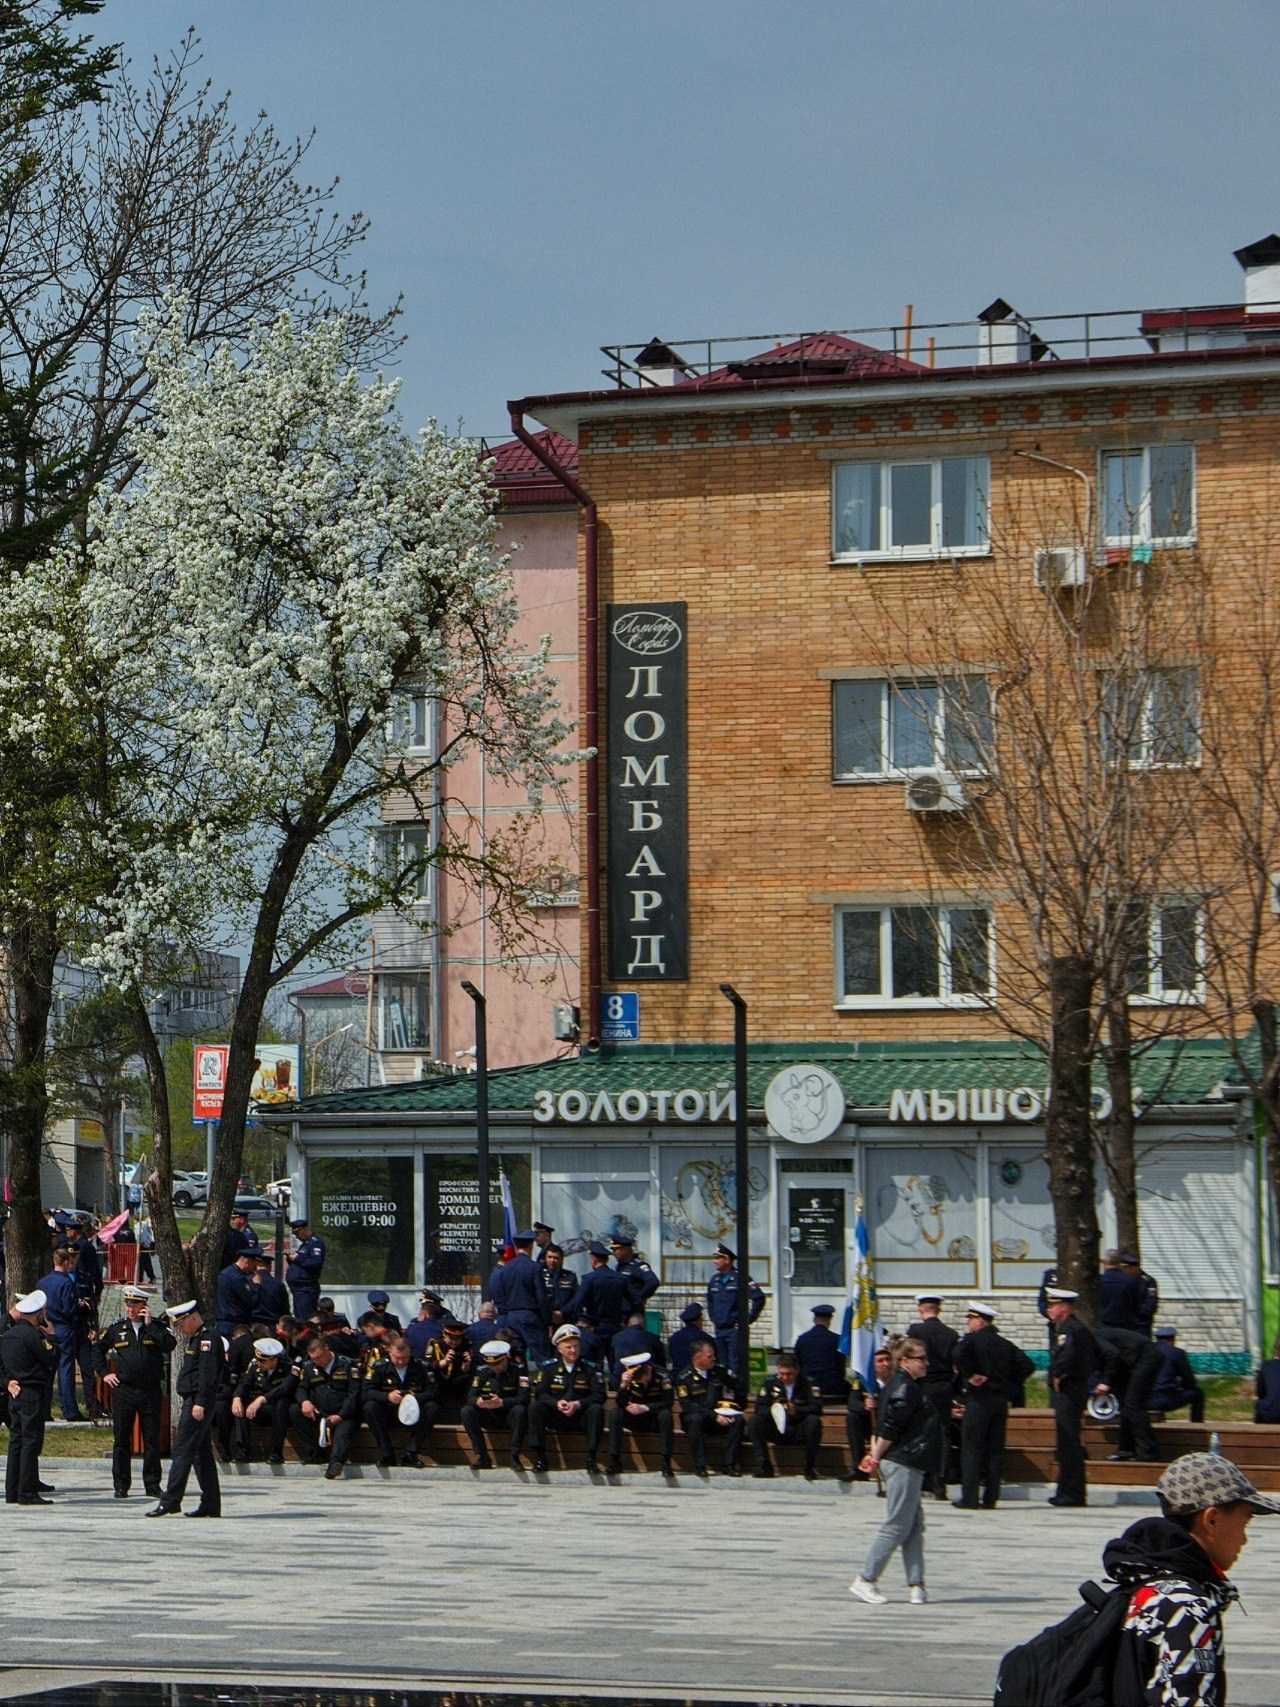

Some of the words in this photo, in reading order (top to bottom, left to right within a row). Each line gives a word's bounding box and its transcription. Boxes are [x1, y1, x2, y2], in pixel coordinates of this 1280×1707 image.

[620, 665, 670, 975] ЛОМБАРД
[608, 995, 623, 1020] 8
[534, 1082, 736, 1122] ЗОЛОТОЙ
[888, 1087, 1144, 1121] МЫШОО
[439, 1195, 504, 1205] ДОМАШЕГ
[322, 1202, 397, 1213] ЕЖЕДНЕВНО
[439, 1206, 480, 1216] УХОДА
[322, 1215, 349, 1226] 9:00
[362, 1215, 395, 1226] 19:00
